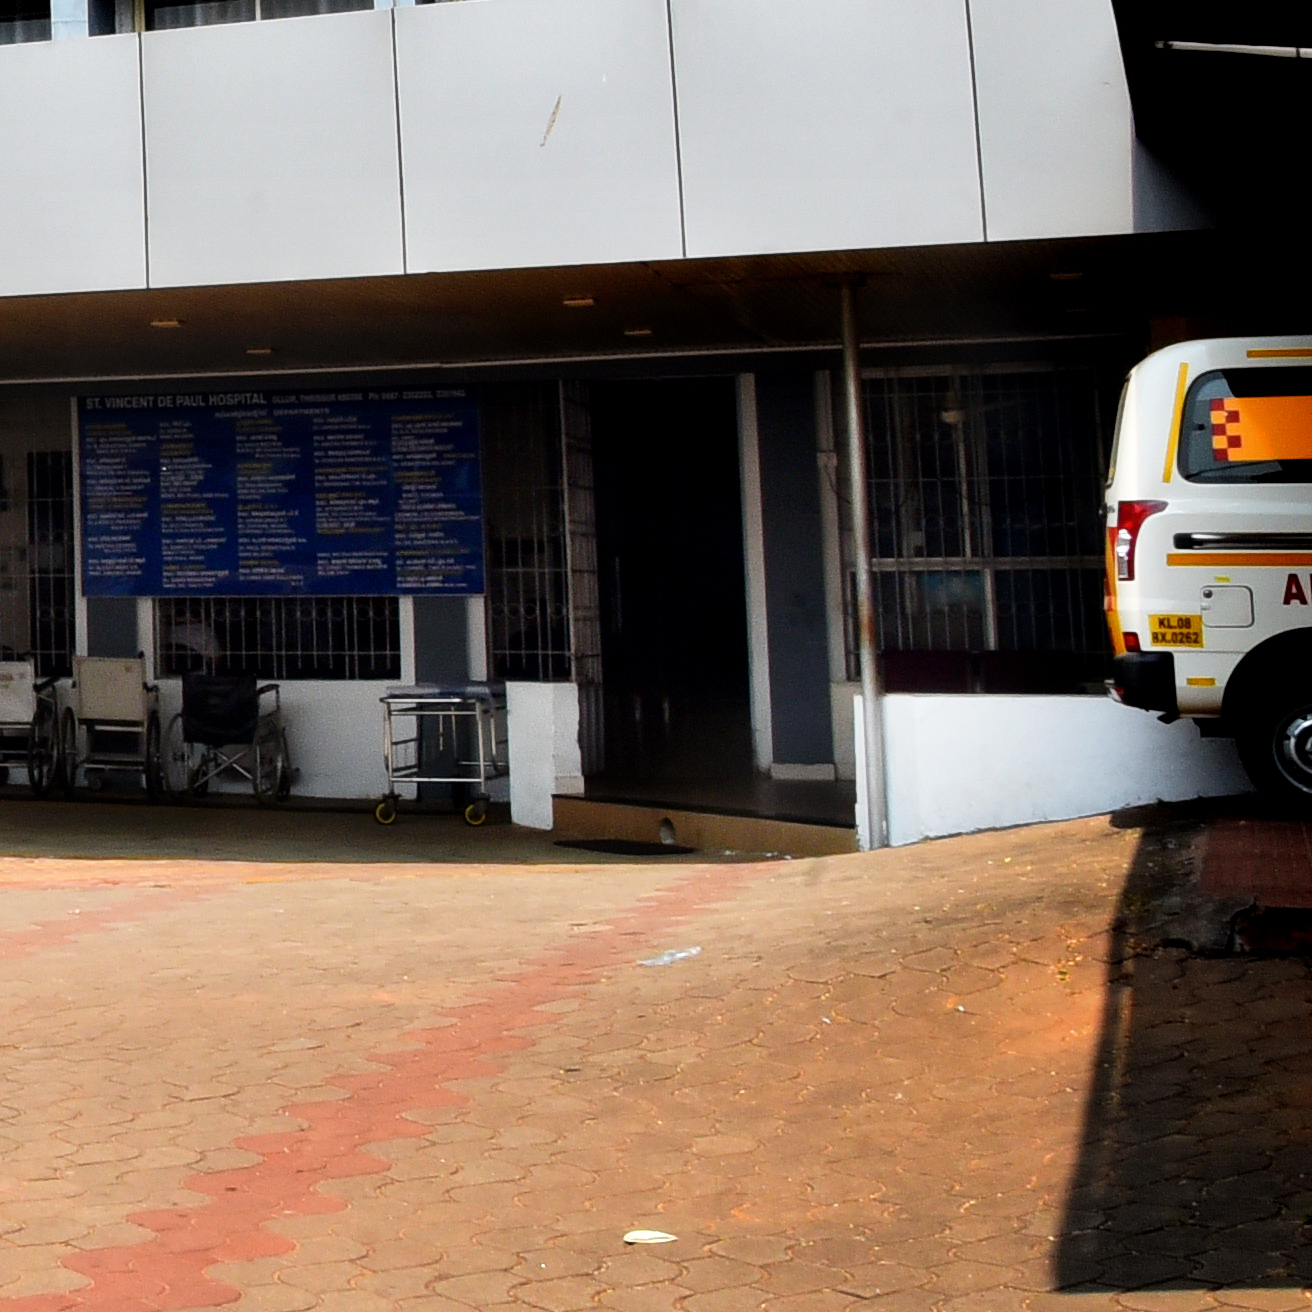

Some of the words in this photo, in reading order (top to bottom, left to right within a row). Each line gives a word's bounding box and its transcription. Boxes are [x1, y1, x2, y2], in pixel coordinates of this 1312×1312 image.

[105, 396, 155, 409] VINCENT
[157, 395, 174, 408] DE
[176, 394, 206, 407] PAUL
[208, 392, 268, 406] HOSPITAL
[1158, 617, 1192, 630] KL.08
